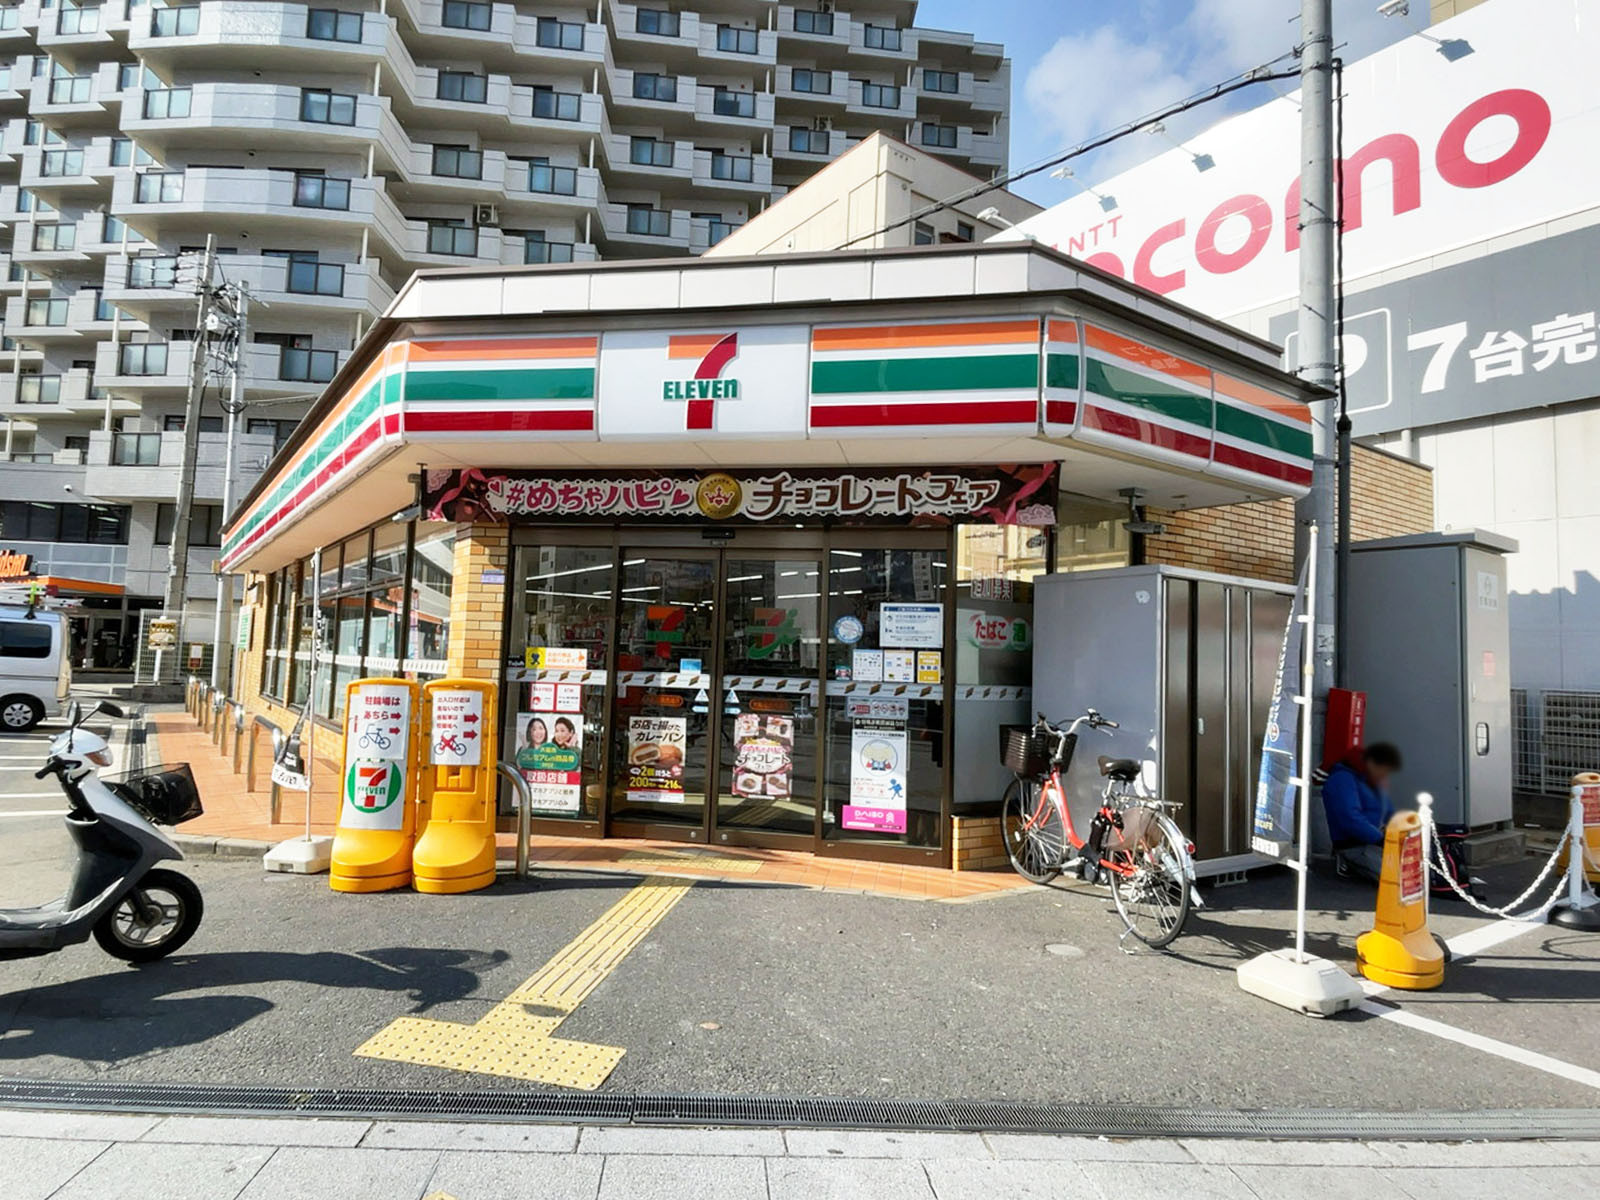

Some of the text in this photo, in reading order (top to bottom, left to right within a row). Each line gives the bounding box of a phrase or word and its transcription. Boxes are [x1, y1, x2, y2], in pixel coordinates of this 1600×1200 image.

[1083, 87, 1552, 296] como
[1068, 214, 1123, 257] NTT
[1407, 310, 1600, 395] 7台完
[976, 620, 1007, 641] たばこ
[364, 711, 389, 720] あちら
[631, 720, 681, 731] お店で揚げた
[635, 732, 685, 743] カレーパン
[736, 751, 790, 766] チョコレート
